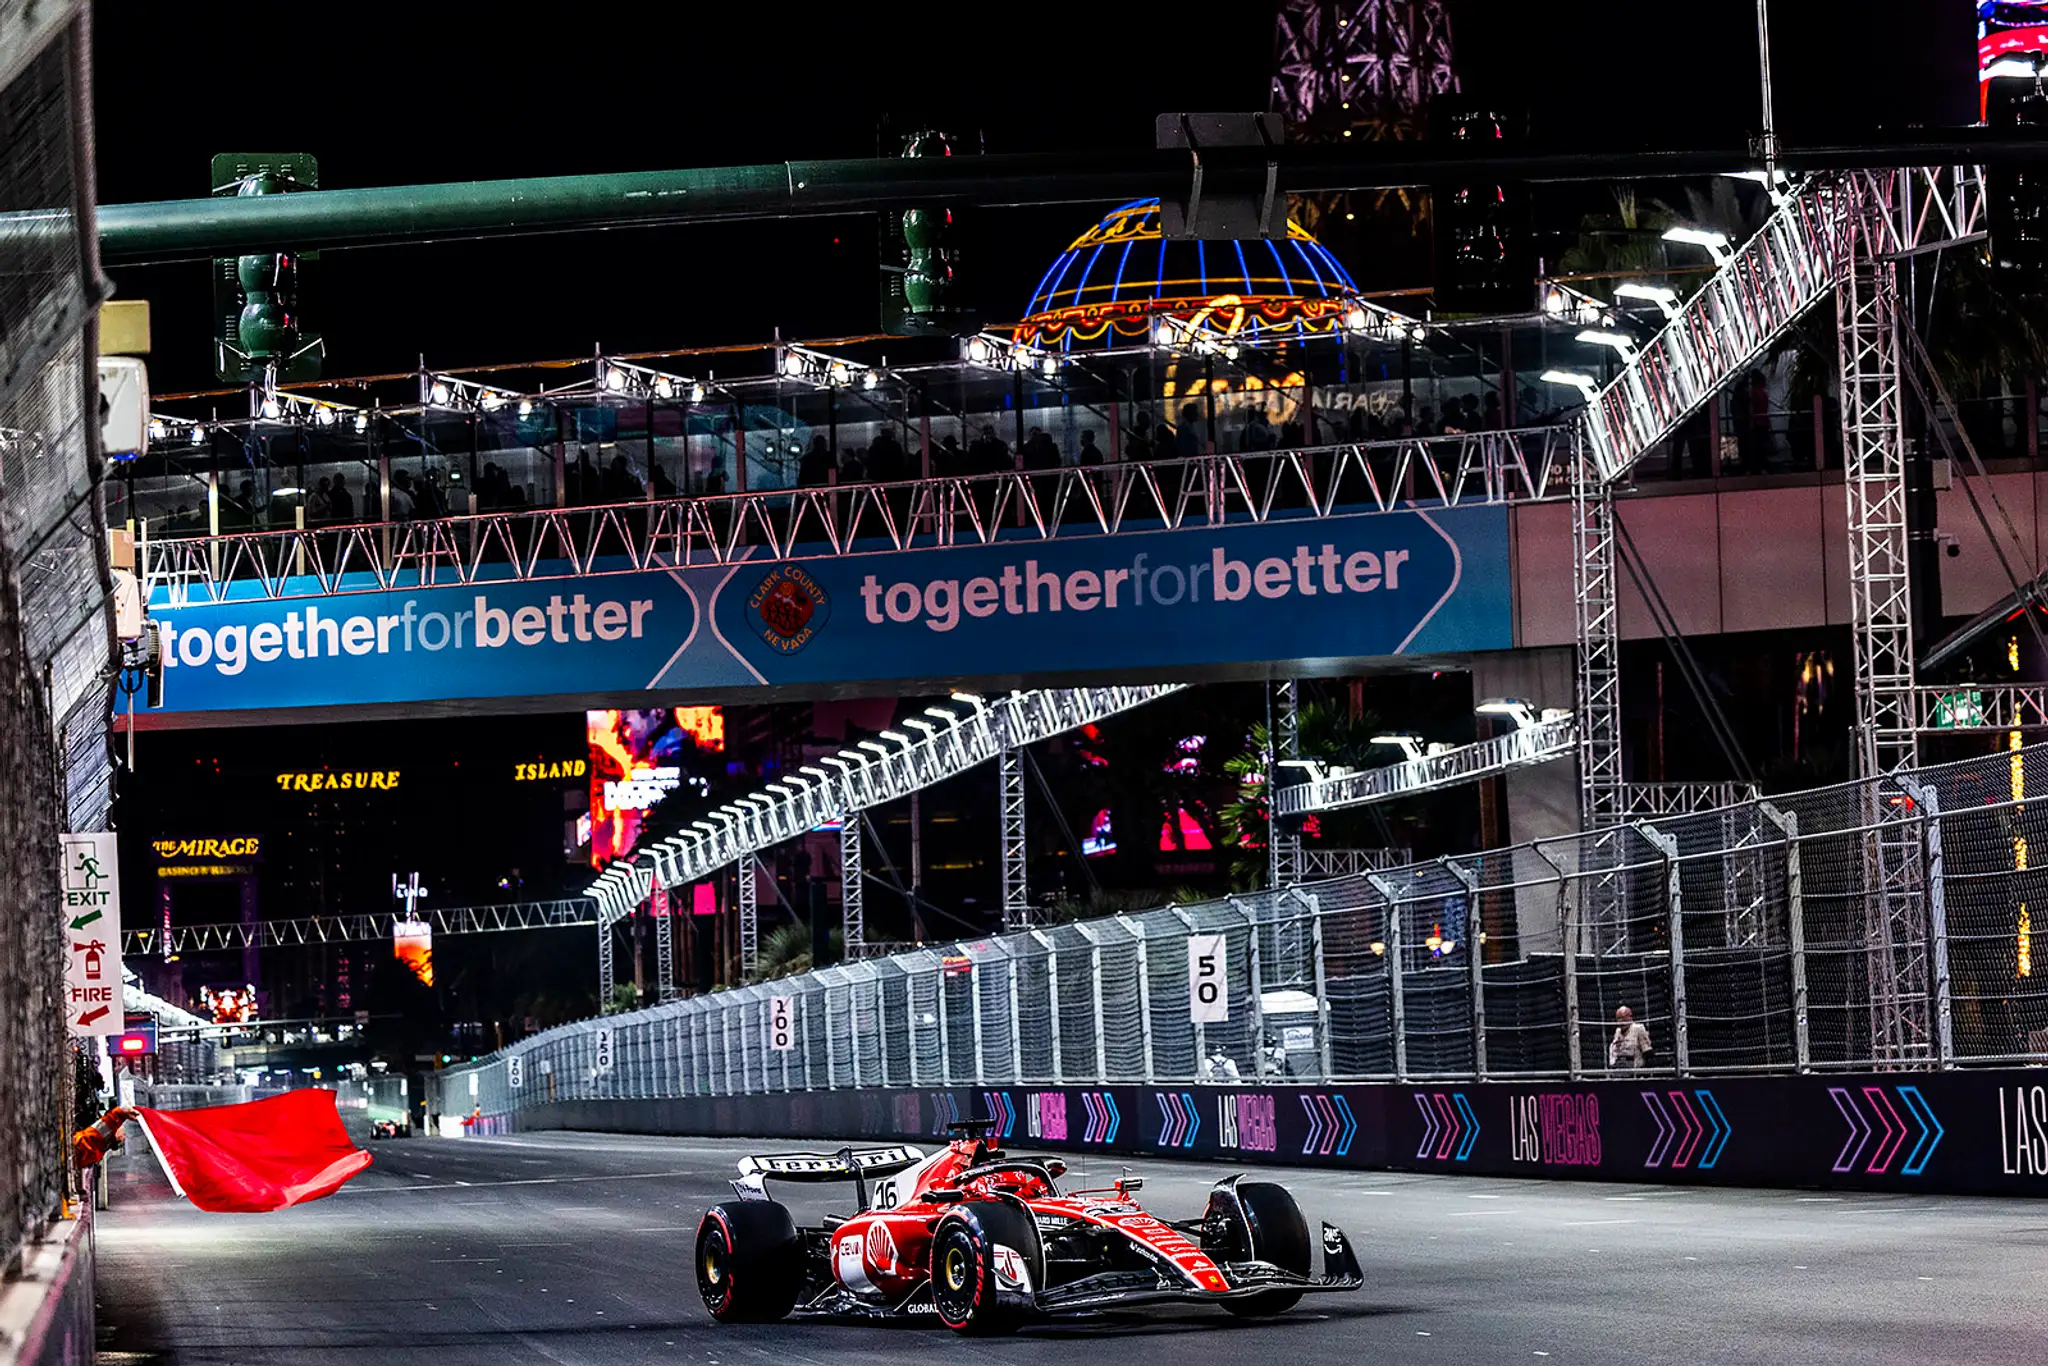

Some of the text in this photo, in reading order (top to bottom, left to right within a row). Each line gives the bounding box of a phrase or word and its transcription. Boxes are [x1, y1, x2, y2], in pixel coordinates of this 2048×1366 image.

[750, 565, 825, 609] CLARK COUNTY
[860, 544, 1409, 632] togetherforbetter
[161, 594, 653, 676] togetherforbetter
[764, 627, 812, 651] NEVADA
[276, 760, 586, 792] TREASURE ISLAND
[161, 838, 260, 858] MIRAGE
[158, 866, 199, 877] CASINO
[67, 891, 111, 906] EXIT
[72, 987, 113, 1002] FIRE
[1198, 955, 1218, 1004] 50
[775, 1000, 788, 1046] 100
[1218, 1094, 1277, 1152] LAS VEGAS
[1510, 1093, 1602, 1166] LAS VEGAS
[1999, 1086, 2048, 1175] LAS
[875, 1181, 897, 1209] 16
[974, 1252, 985, 1306] ZERO
[908, 1303, 940, 1314] GLOBAL
